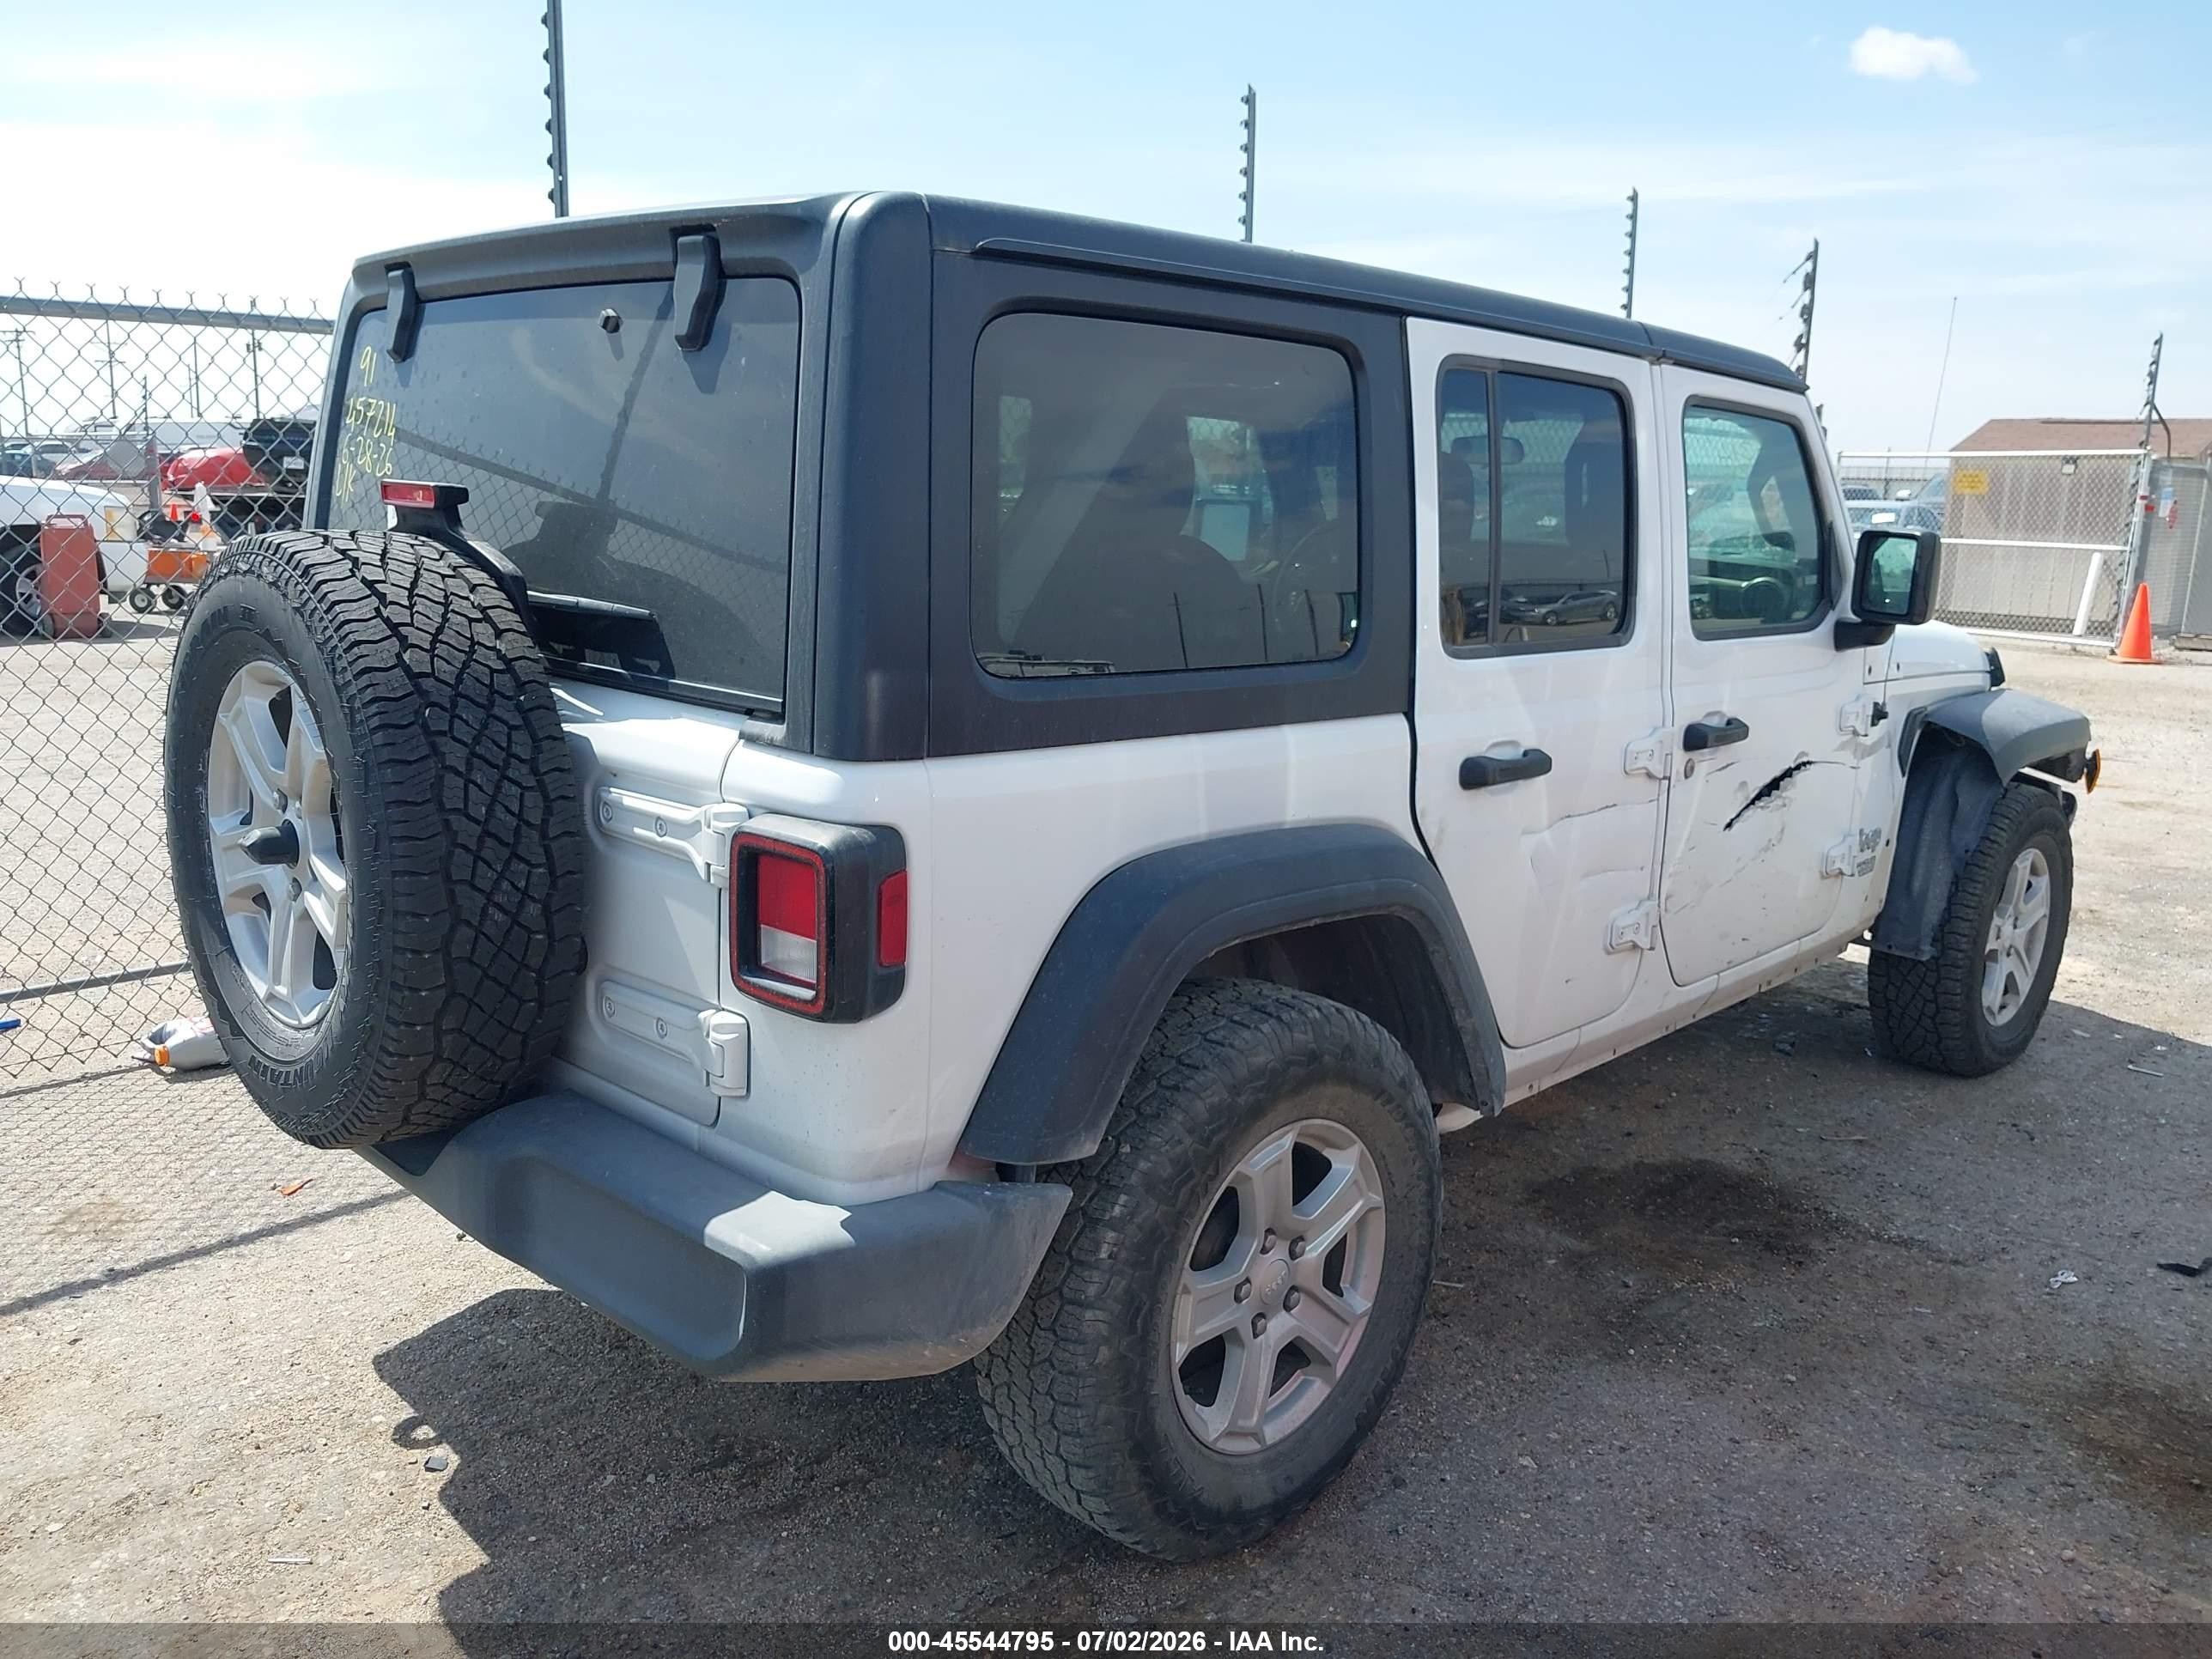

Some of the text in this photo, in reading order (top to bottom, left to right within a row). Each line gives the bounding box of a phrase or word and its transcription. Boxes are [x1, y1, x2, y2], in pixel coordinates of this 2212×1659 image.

[359, 343, 377, 387] 91
[345, 396, 397, 447] 457214
[342, 433, 393, 477] 6-28-26
